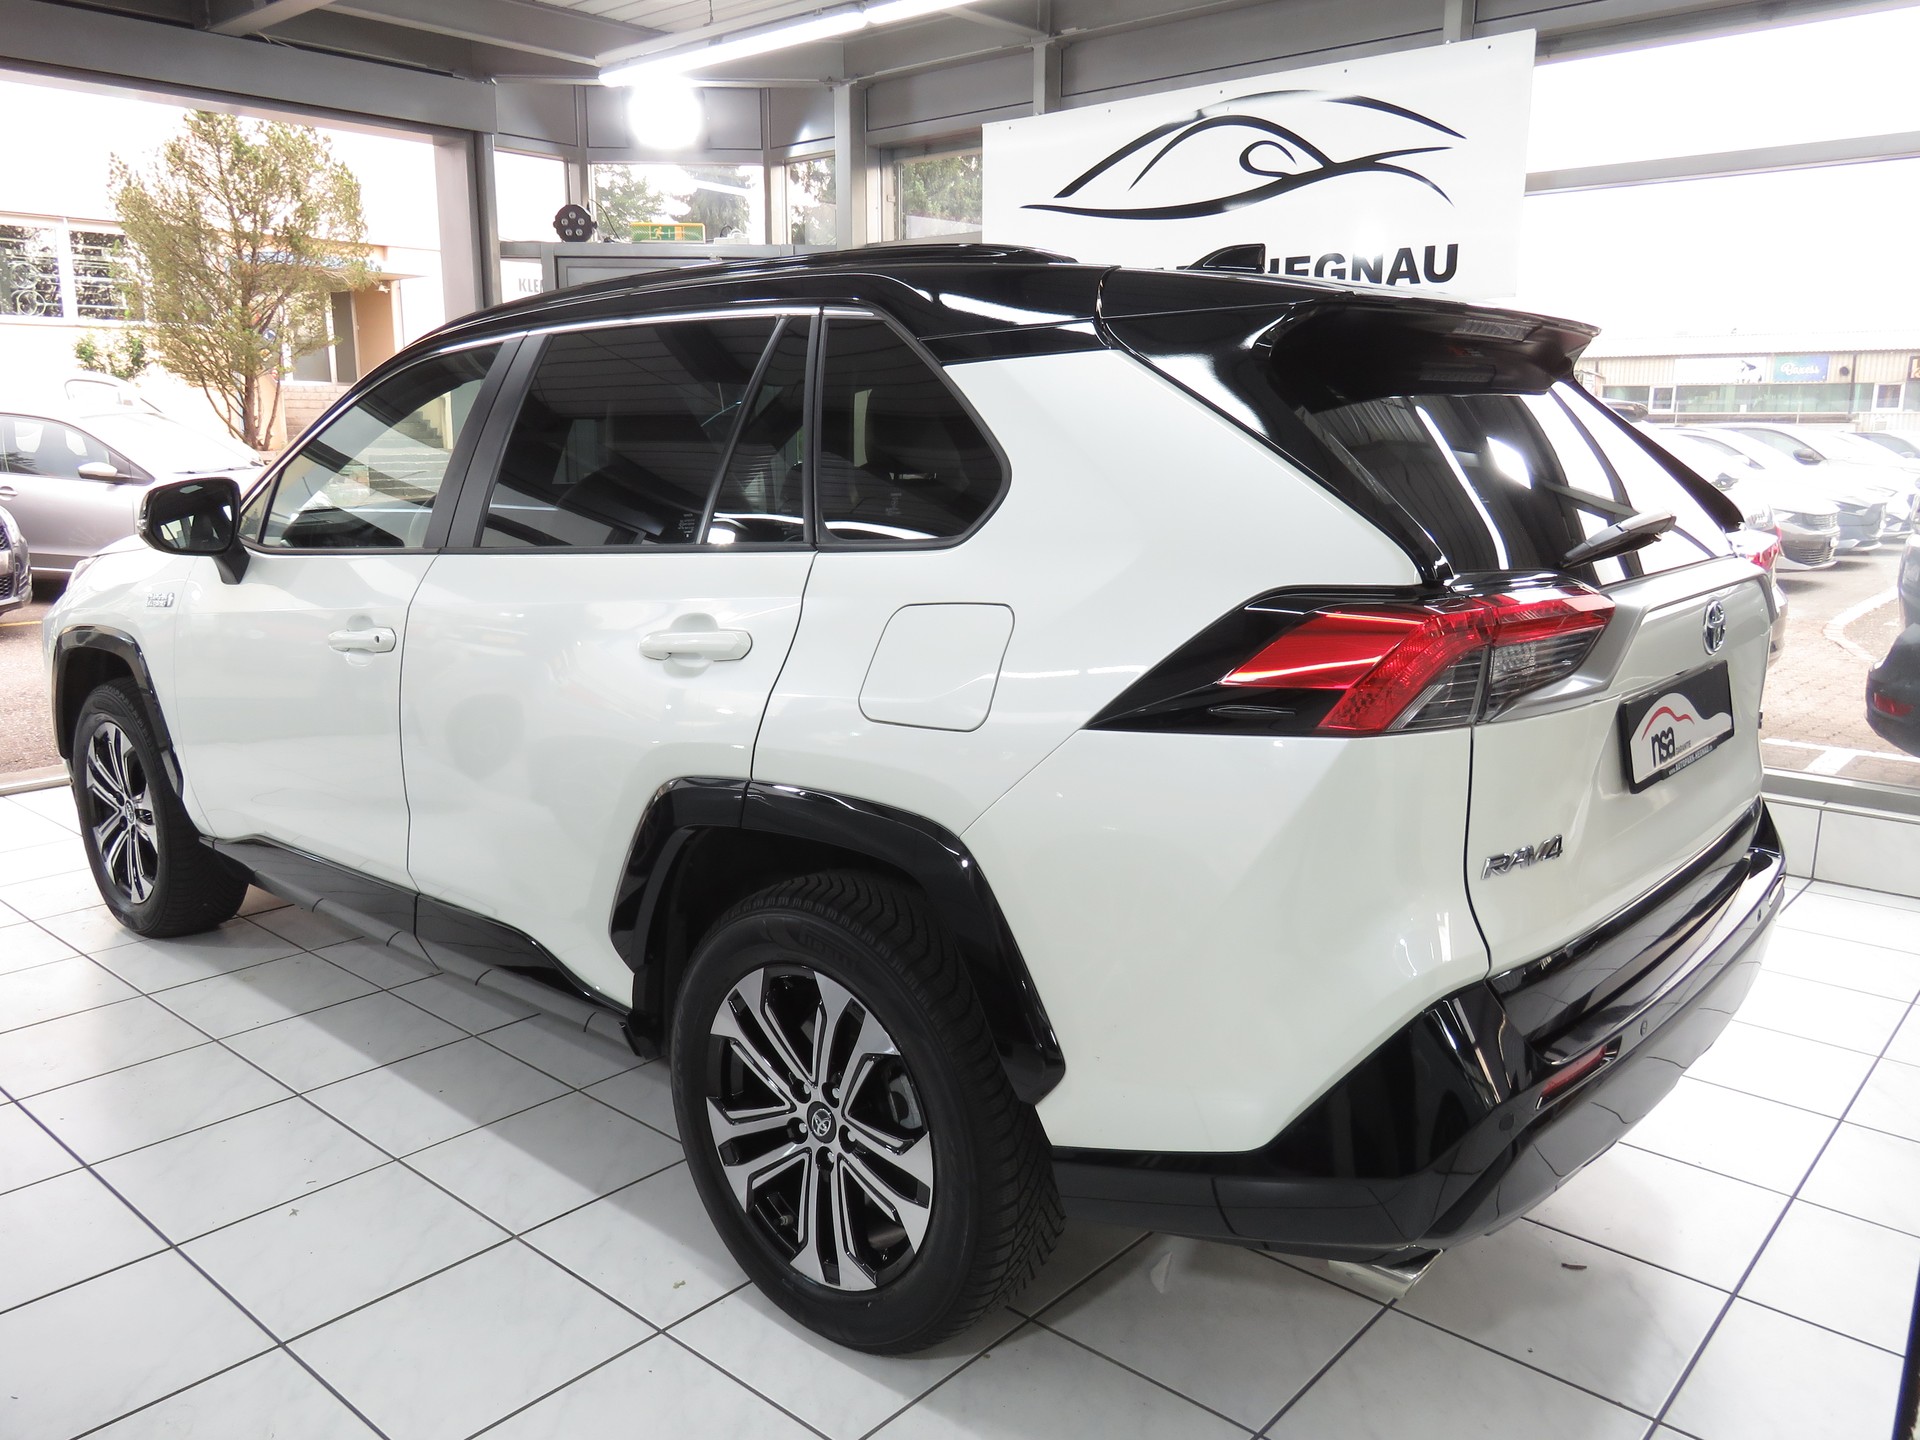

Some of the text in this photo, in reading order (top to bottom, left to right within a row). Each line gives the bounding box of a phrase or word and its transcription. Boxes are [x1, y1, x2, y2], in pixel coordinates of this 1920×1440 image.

[518, 278, 543, 293] KLE
[1651, 726, 1676, 768] nsa
[1480, 834, 1563, 880] RAV4
